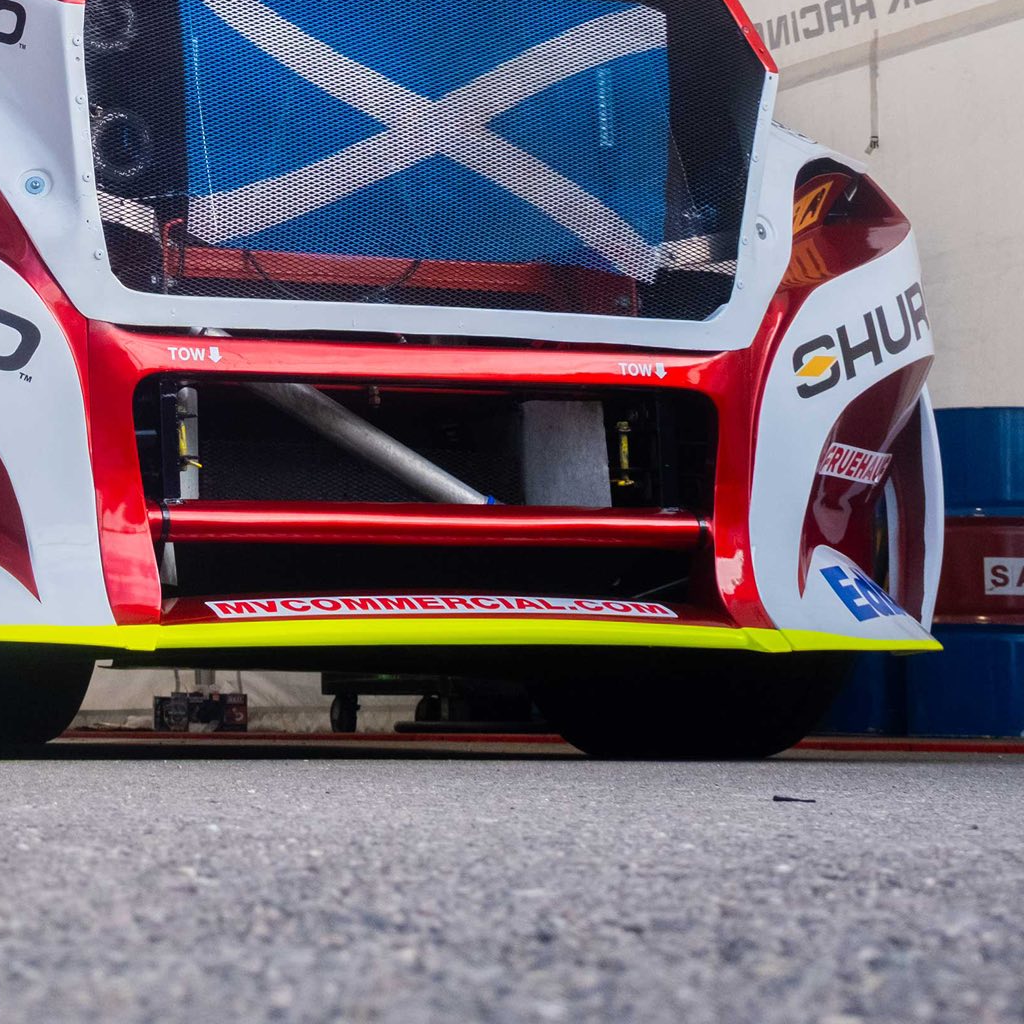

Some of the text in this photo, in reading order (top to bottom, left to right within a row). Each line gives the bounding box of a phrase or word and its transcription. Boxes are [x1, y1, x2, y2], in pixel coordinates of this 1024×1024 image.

[792, 281, 930, 399] SHUR
[167, 346, 206, 361] TOW
[617, 362, 653, 377] TOW
[217, 595, 670, 616] MVCOMMERCIAL.COM
